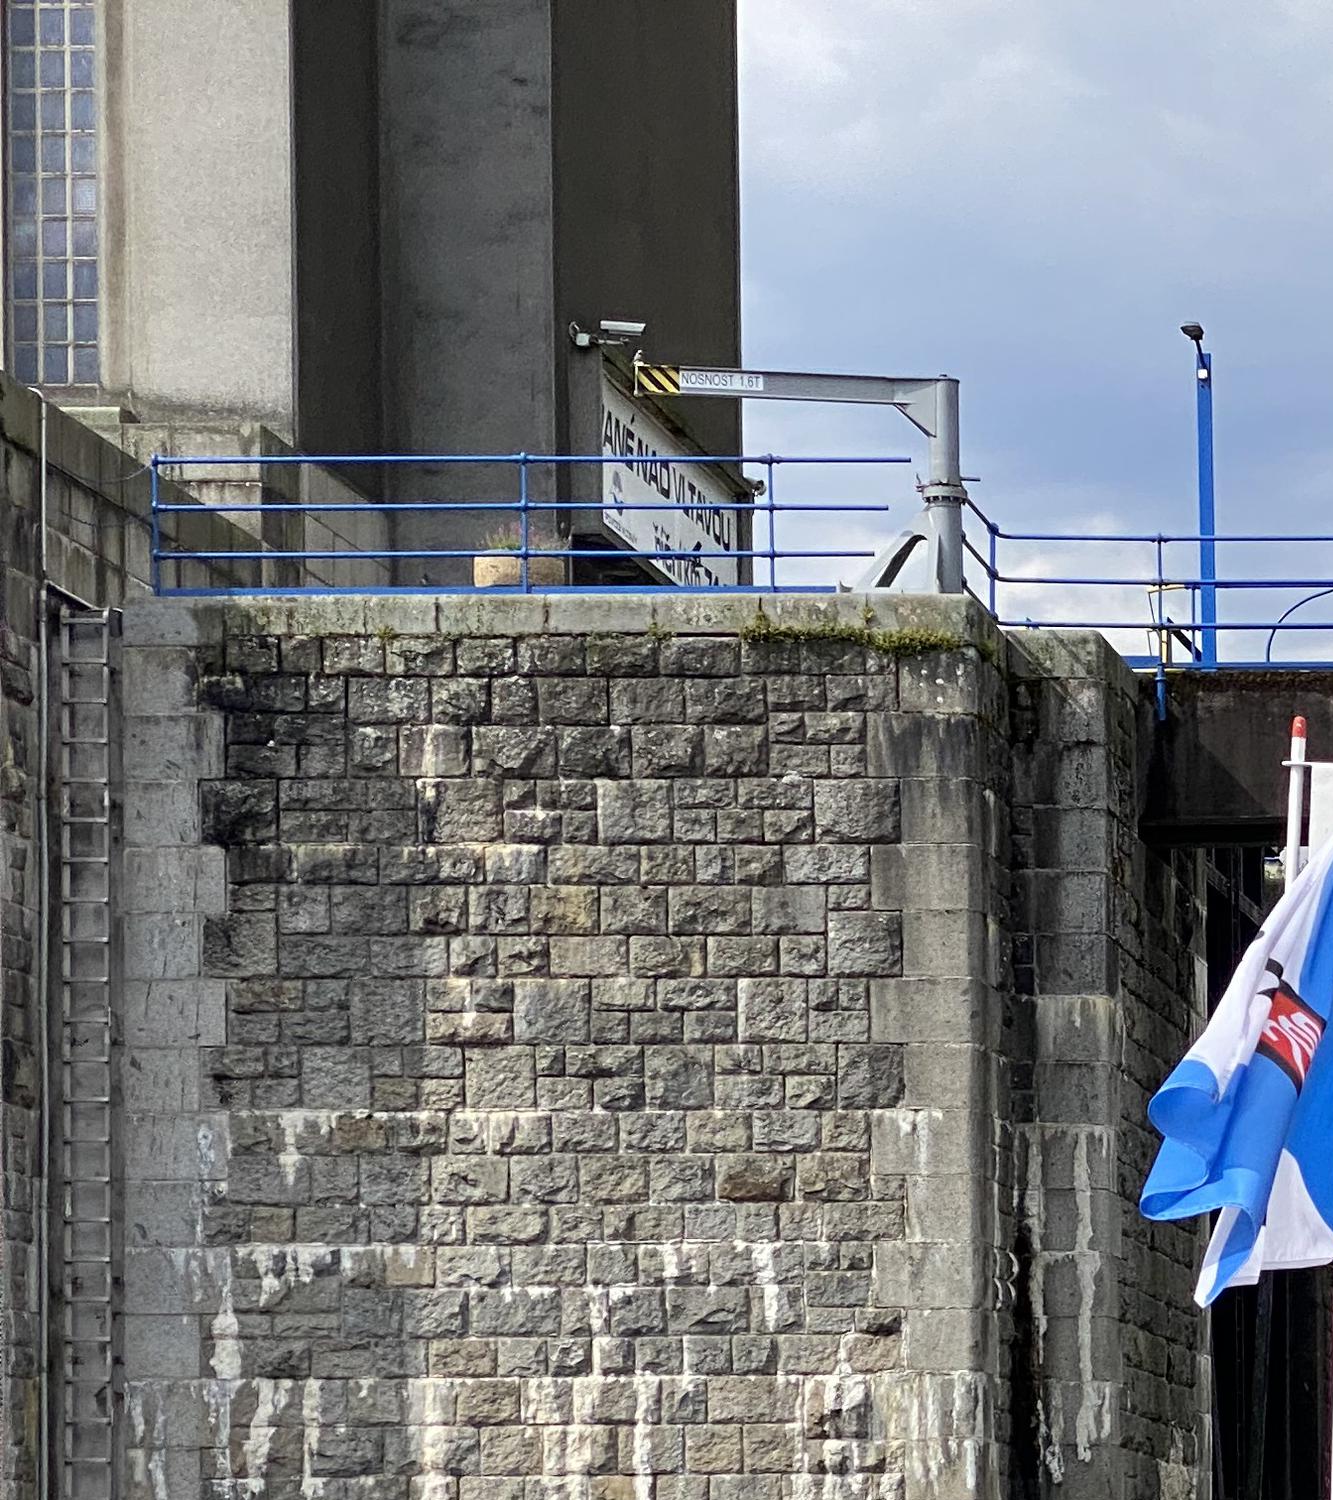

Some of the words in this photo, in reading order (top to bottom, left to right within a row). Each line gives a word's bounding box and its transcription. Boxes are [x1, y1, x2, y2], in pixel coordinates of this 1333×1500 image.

[681, 372, 734, 387] NOSNOST
[602, 404, 635, 471] ANÉ
[637, 437, 670, 499] NAD
